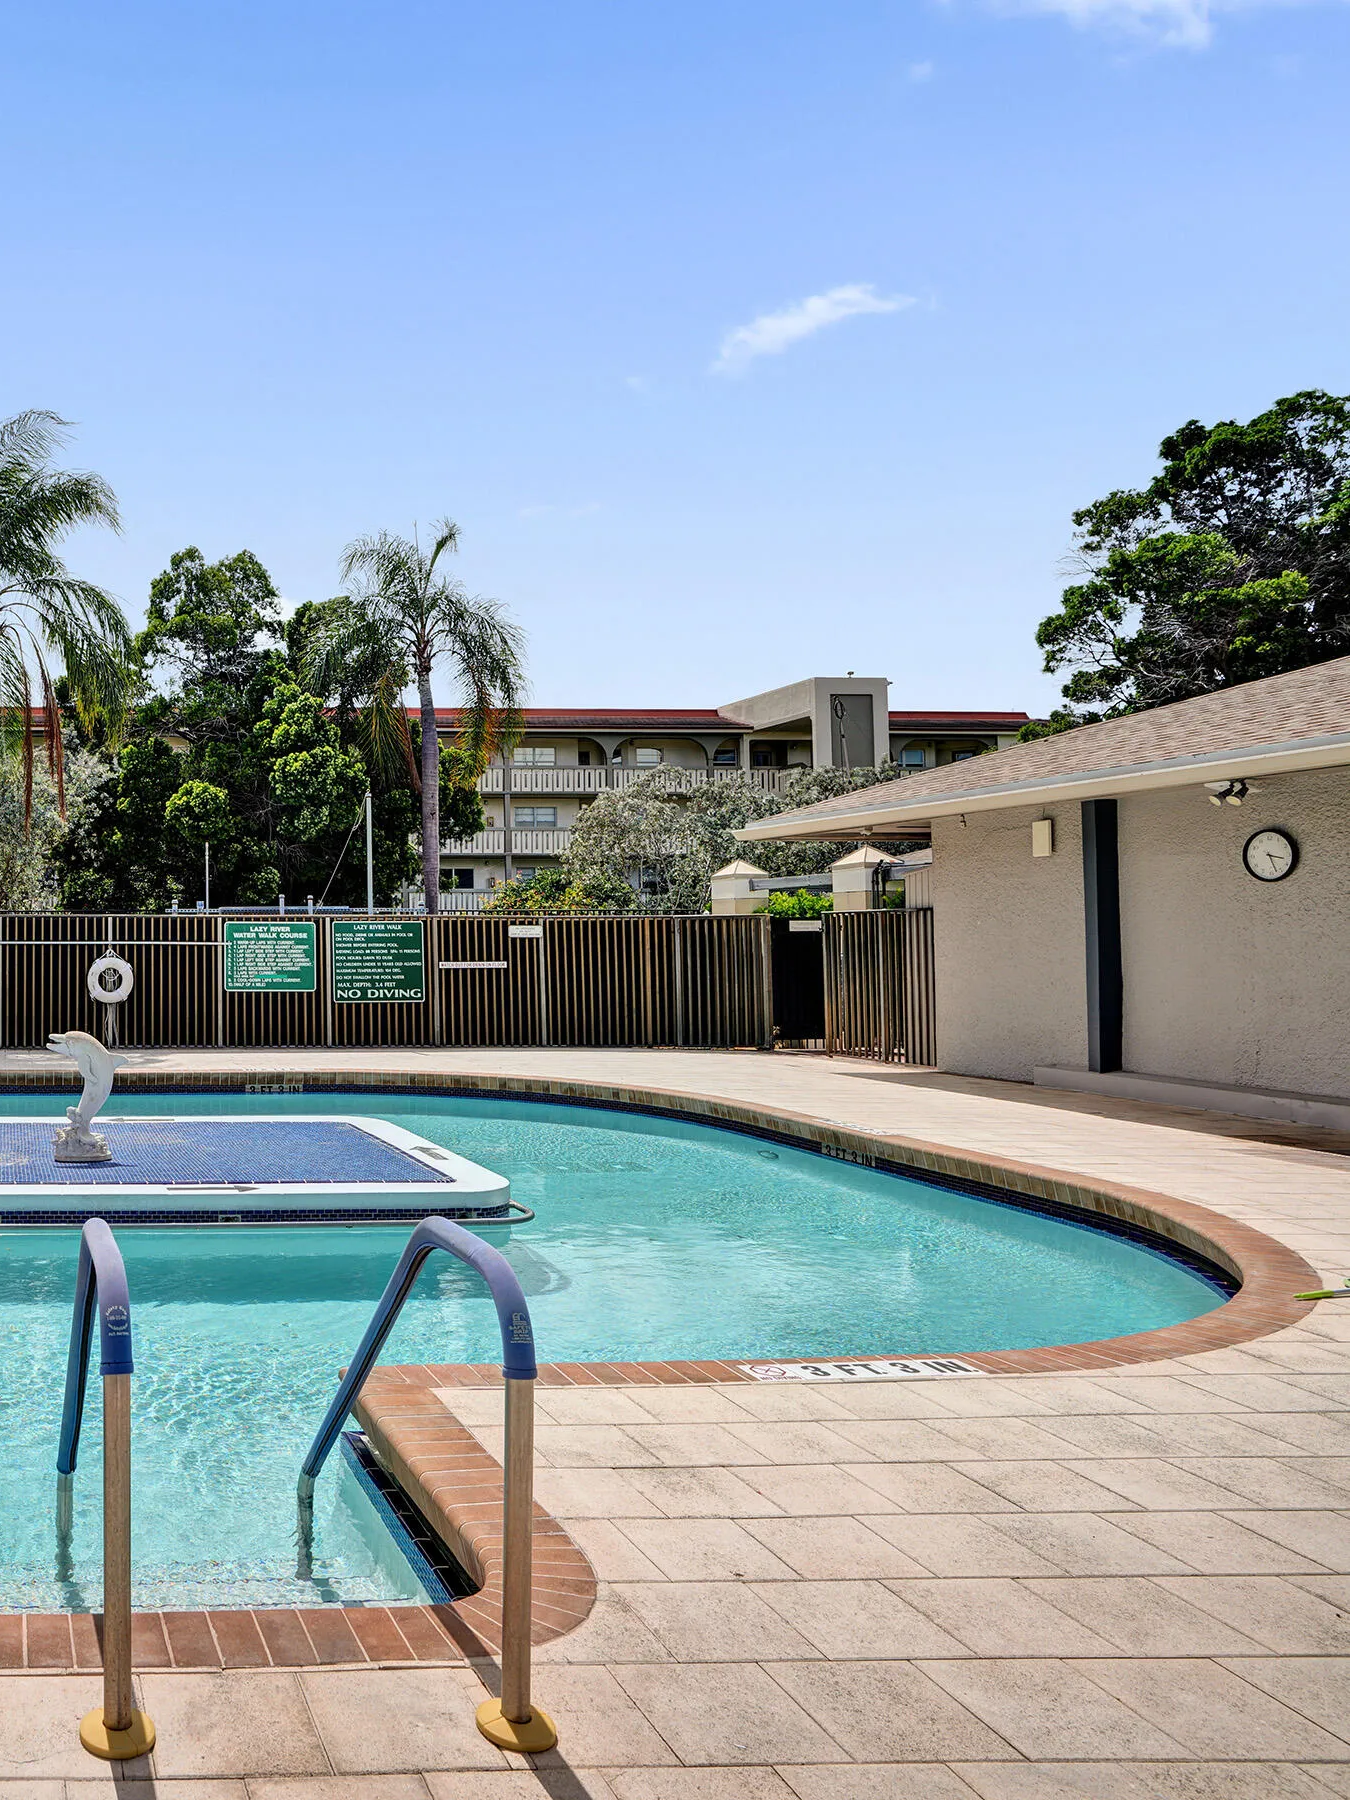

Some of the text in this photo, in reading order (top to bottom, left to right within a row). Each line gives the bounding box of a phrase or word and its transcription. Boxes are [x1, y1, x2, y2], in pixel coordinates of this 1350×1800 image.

[337, 989, 421, 998] NO DIVING
[288, 1085, 300, 1094] IN
[826, 1144, 873, 1167] 3 FT 3 IN
[800, 1360, 979, 1376] 3 FT. 3 IN.
